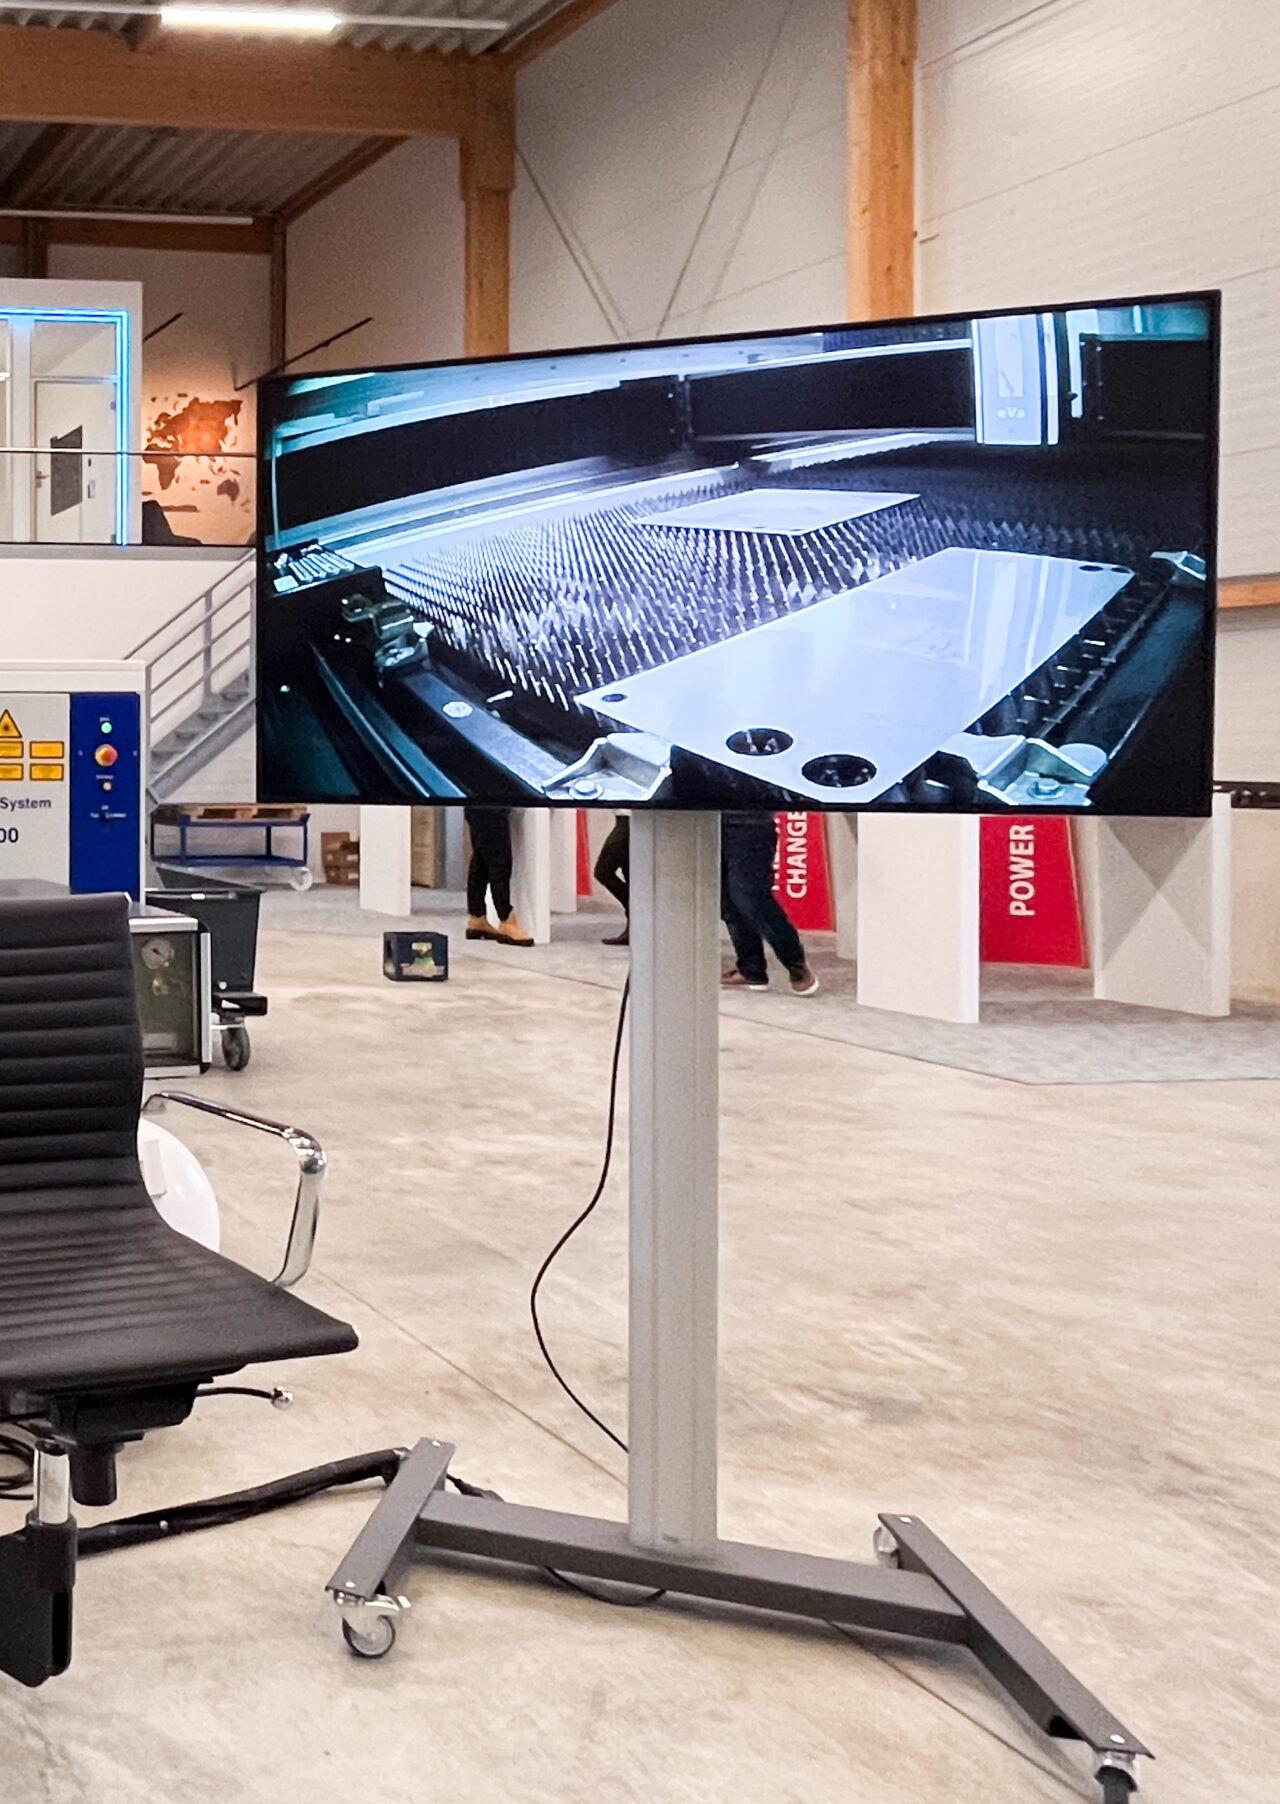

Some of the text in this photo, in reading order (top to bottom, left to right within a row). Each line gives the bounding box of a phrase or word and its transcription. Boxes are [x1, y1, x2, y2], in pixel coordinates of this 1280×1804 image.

[0, 797, 52, 812] System
[786, 811, 808, 898] CHANGE
[1009, 824, 1035, 916] POWER
